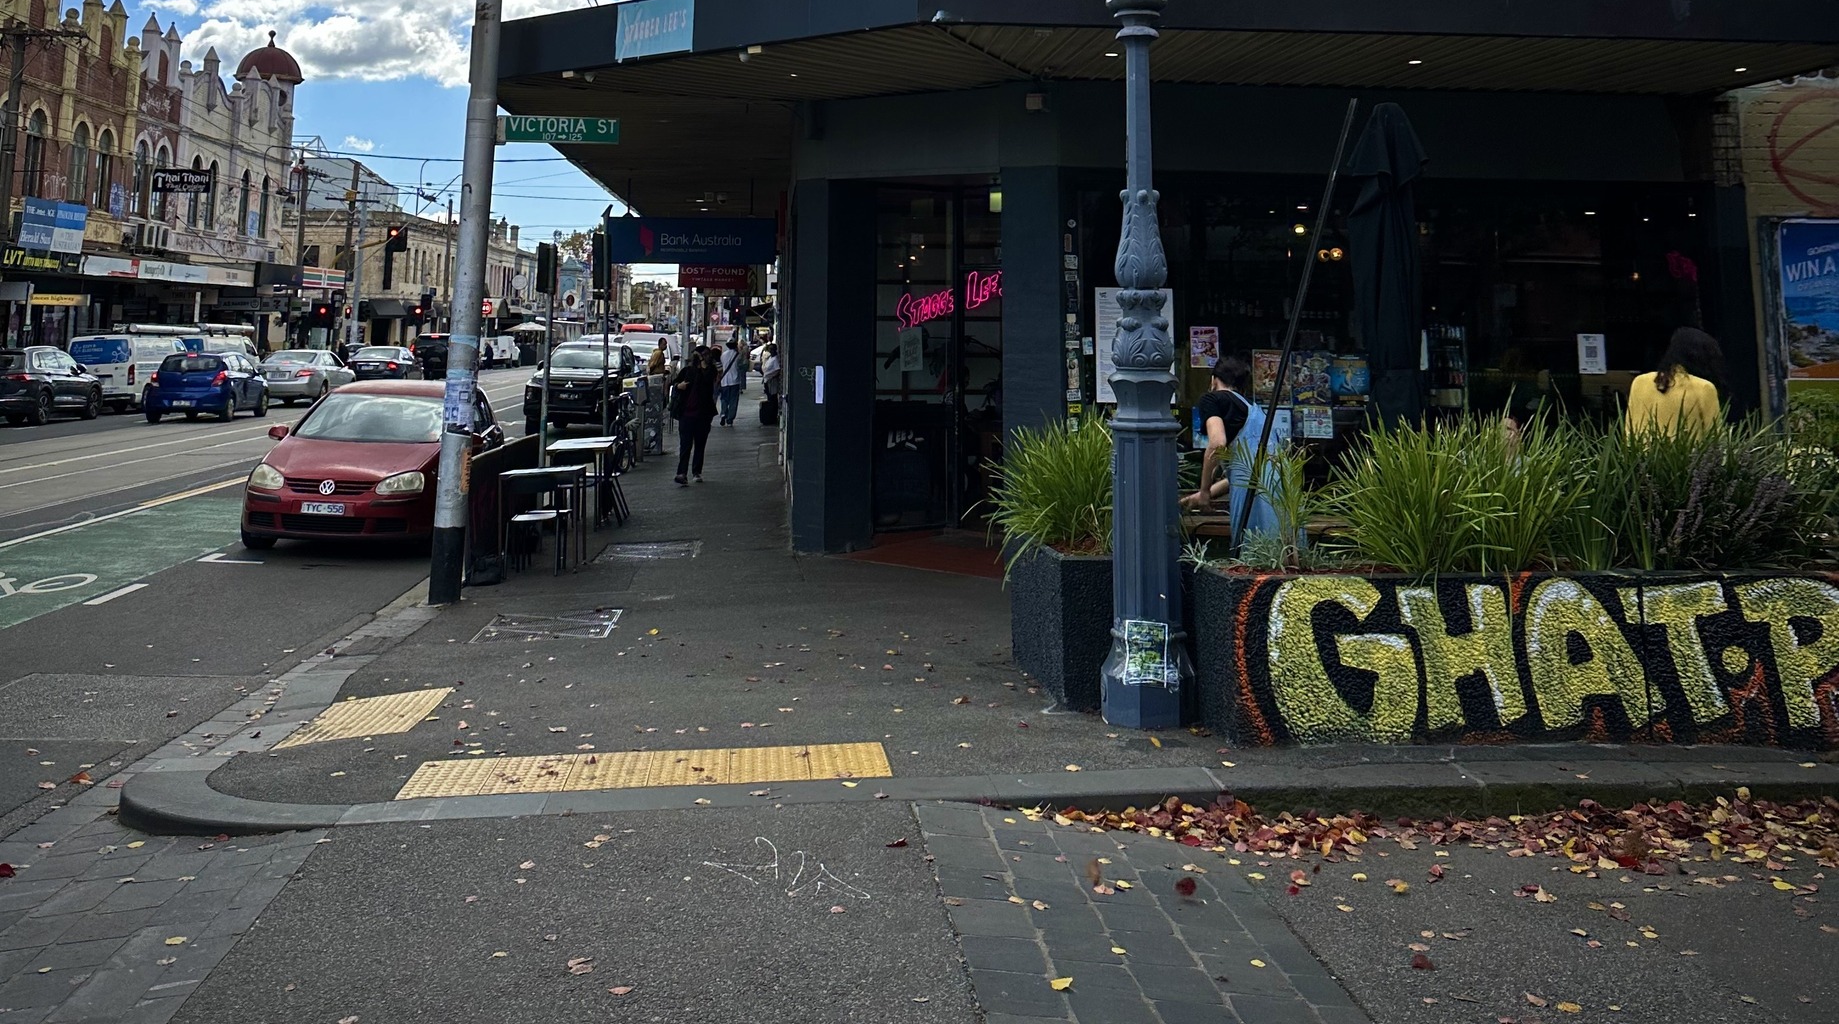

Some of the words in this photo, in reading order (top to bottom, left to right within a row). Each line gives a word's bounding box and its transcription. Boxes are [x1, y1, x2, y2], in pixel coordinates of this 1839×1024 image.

[510, 117, 587, 133] VICTORIA
[597, 119, 617, 134] ST
[542, 133, 556, 141] 107
[569, 133, 582, 141] 125
[154, 171, 180, 189] Thai
[181, 171, 209, 184] Thani
[20, 230, 40, 243] Herald
[40, 233, 51, 245] Sun
[660, 233, 689, 246] Bank
[692, 233, 742, 246] Australia
[3, 249, 24, 265] LVT
[681, 267, 705, 275] LOST
[711, 267, 745, 276] FOUND
[1785, 258, 1819, 282] WIN
[1823, 255, 1836, 275] A
